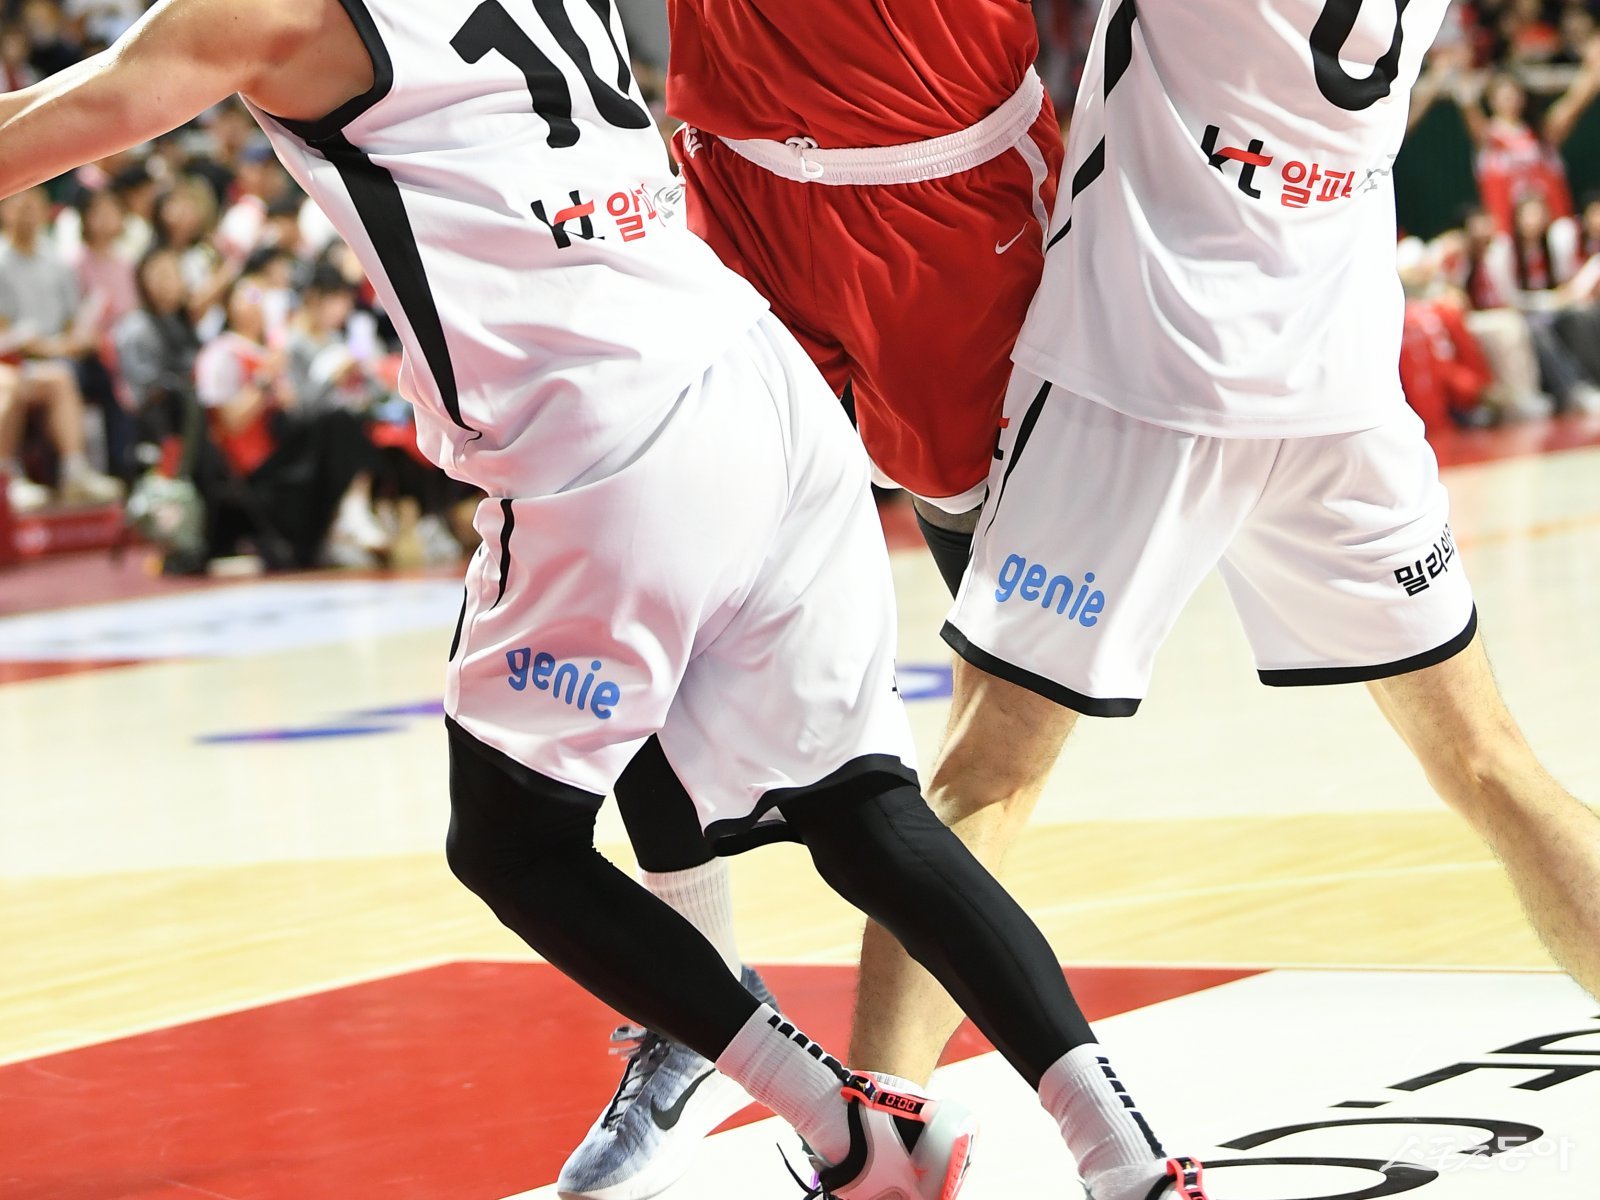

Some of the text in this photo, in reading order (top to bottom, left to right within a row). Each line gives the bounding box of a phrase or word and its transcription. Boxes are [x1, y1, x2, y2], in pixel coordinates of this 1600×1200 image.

[1200, 124, 1273, 200] kt
[995, 554, 1105, 628] genie
[505, 647, 621, 720] genie
[885, 1093, 917, 1112] 0:00
